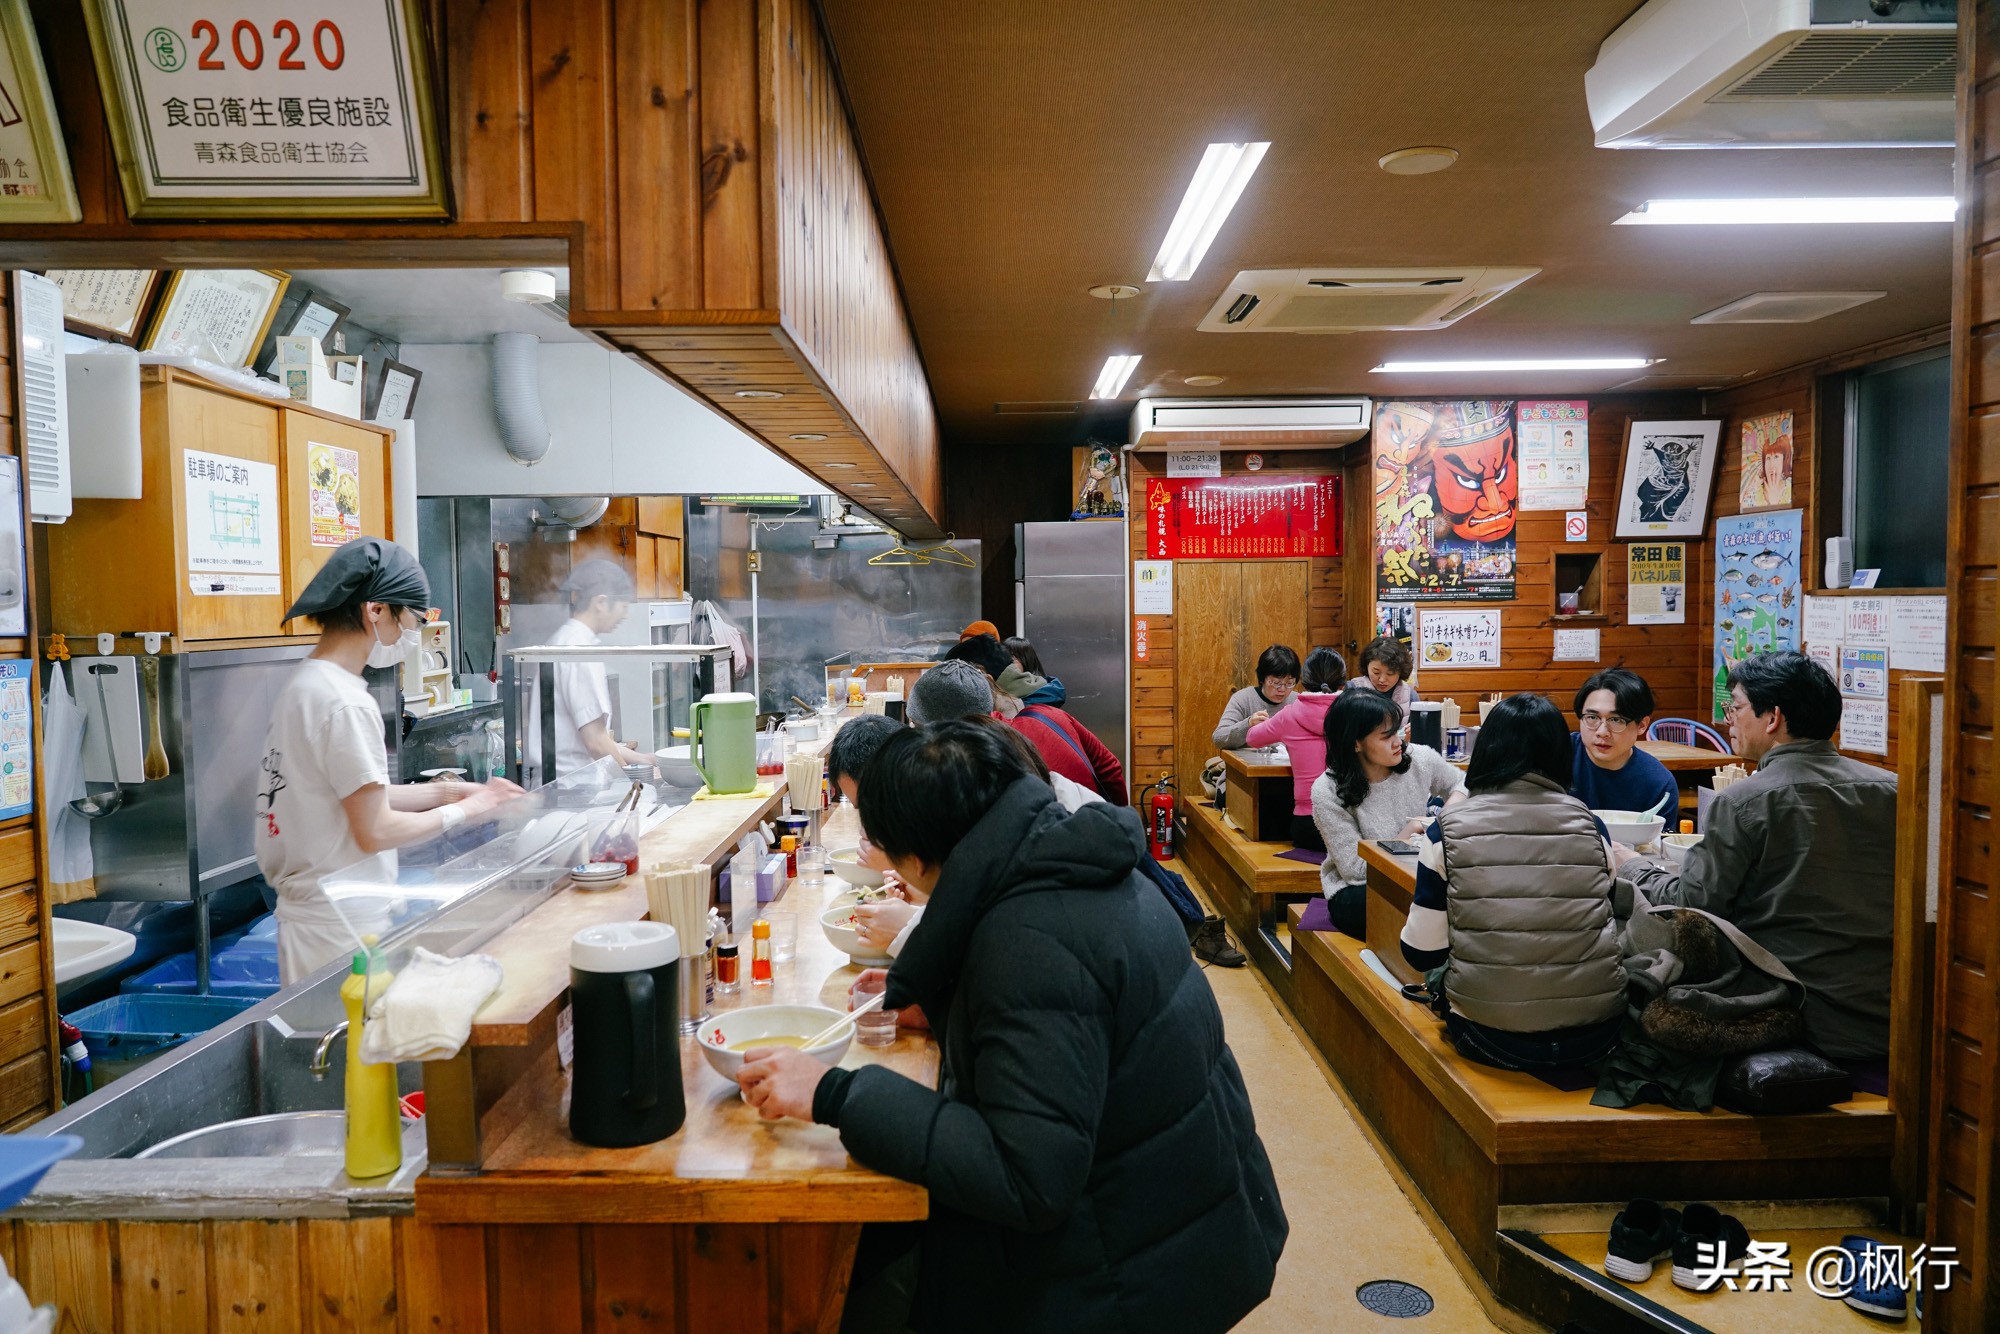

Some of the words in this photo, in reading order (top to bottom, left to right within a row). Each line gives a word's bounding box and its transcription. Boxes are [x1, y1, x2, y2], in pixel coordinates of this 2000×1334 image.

[191, 19, 345, 71] 2020
[163, 97, 393, 128] 食品衛生優良施設
[193, 141, 370, 165] 青森食品衛生協会
[1522, 407, 1585, 420] 子どもを守ろう
[187, 456, 249, 486] 駐車場のご案内
[1157, 505, 1167, 535] 味の札幌
[1631, 546, 1662, 562] 常田
[1632, 570, 1681, 582] パネル展
[1852, 599, 1883, 611] 学生割引
[1136, 620, 1147, 652] 消火器
[1479, 649, 1488, 662] 円
